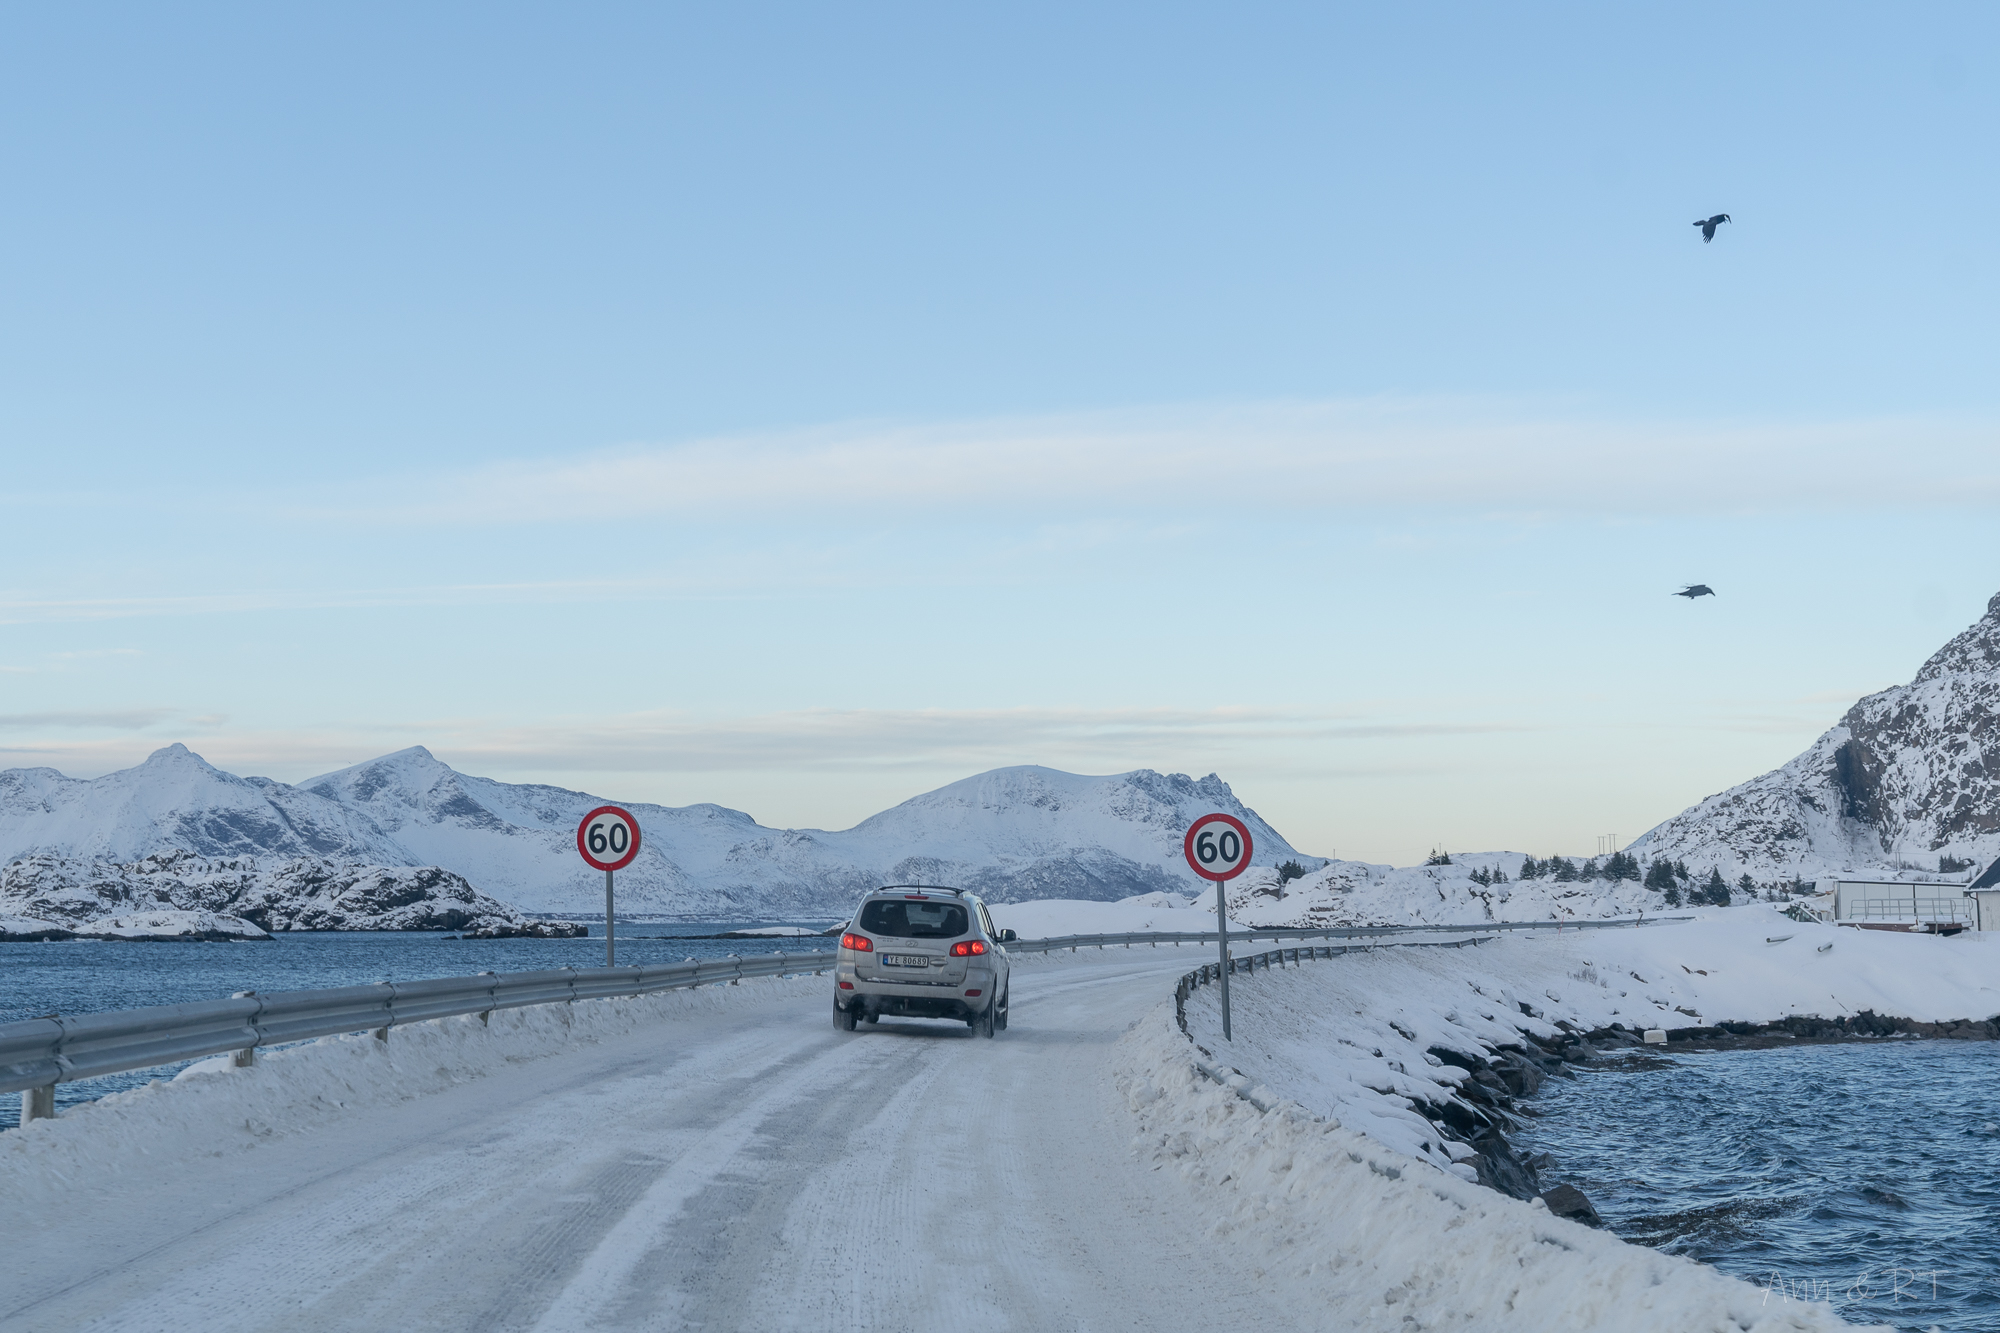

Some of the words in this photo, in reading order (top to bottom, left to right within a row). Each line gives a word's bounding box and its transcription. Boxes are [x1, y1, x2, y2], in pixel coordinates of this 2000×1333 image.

[589, 823, 628, 854] 60
[1197, 831, 1240, 863] 60
[890, 956, 899, 964] YE
[902, 956, 927, 966] 80689
